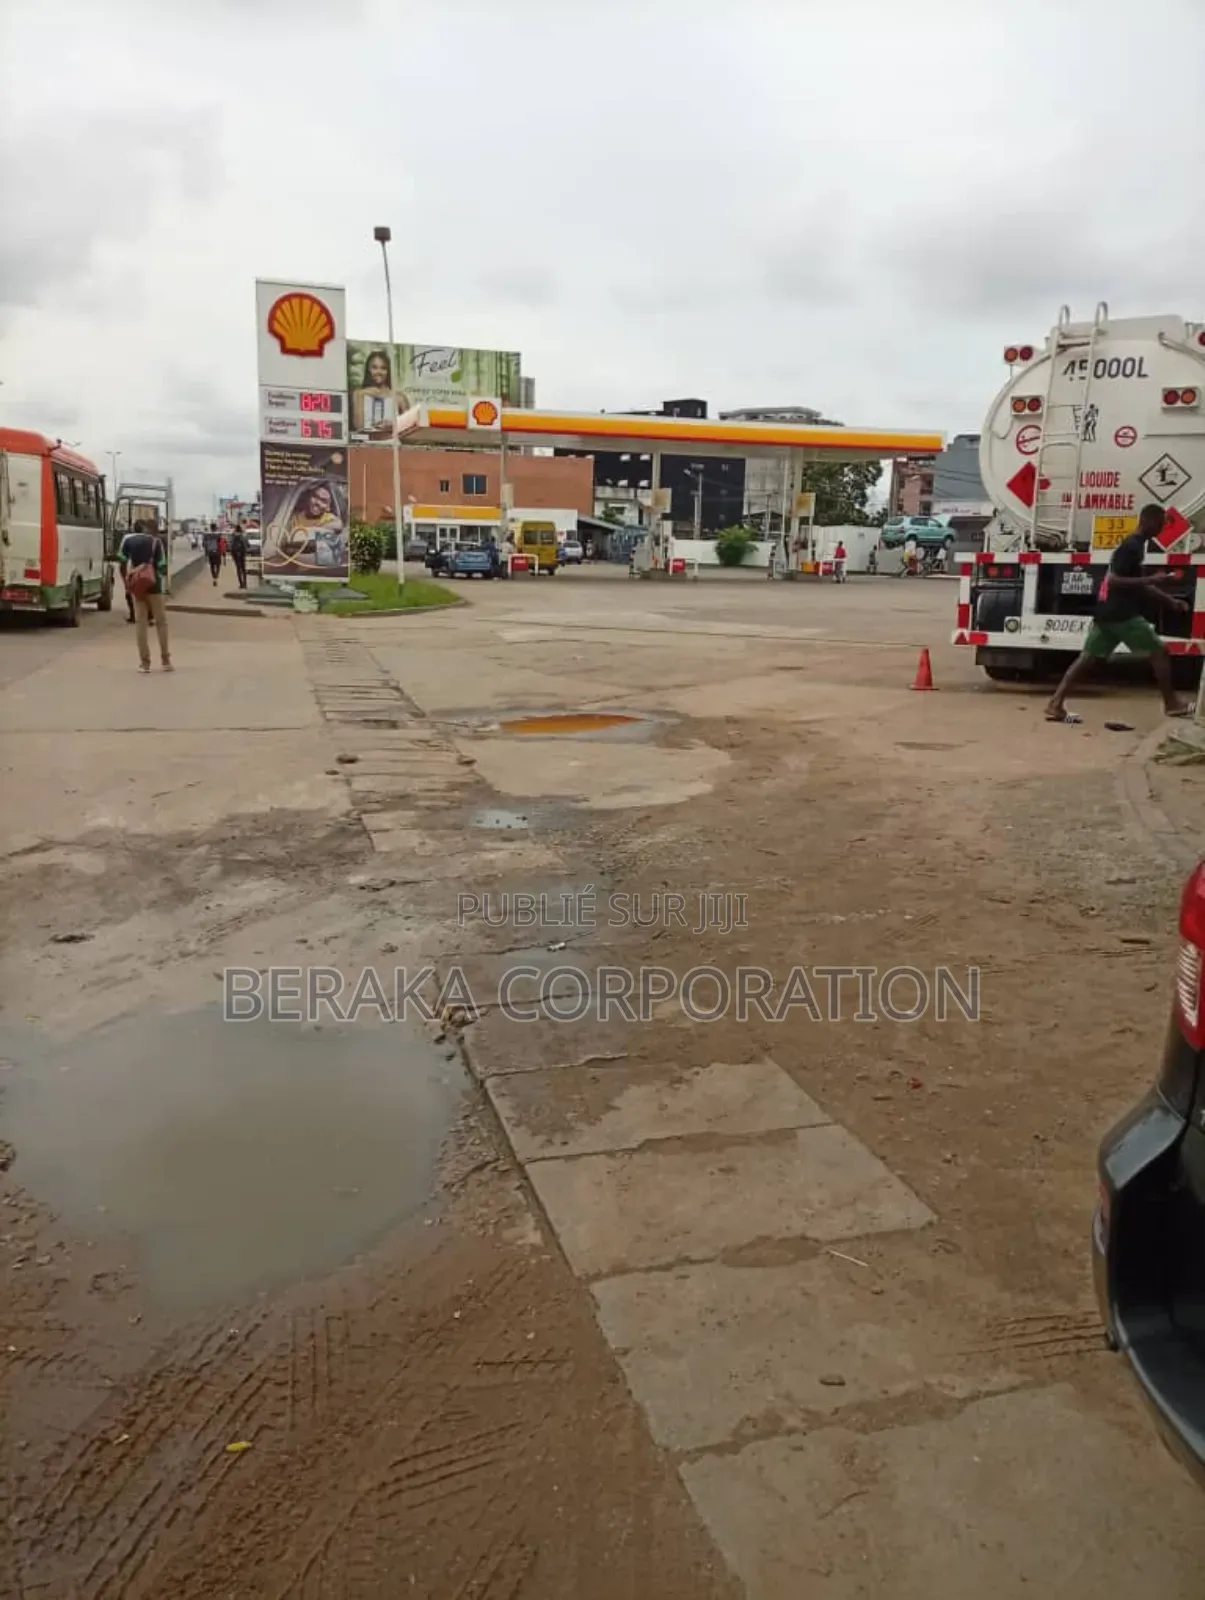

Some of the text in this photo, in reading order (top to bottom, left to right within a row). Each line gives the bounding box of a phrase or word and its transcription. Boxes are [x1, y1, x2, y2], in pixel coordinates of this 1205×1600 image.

[409, 349, 457, 377] Feel
[1063, 356, 1149, 382] 45000L
[1079, 471, 1121, 489] LIQUIDE
[1061, 492, 1135, 511] INLAMMABLE
